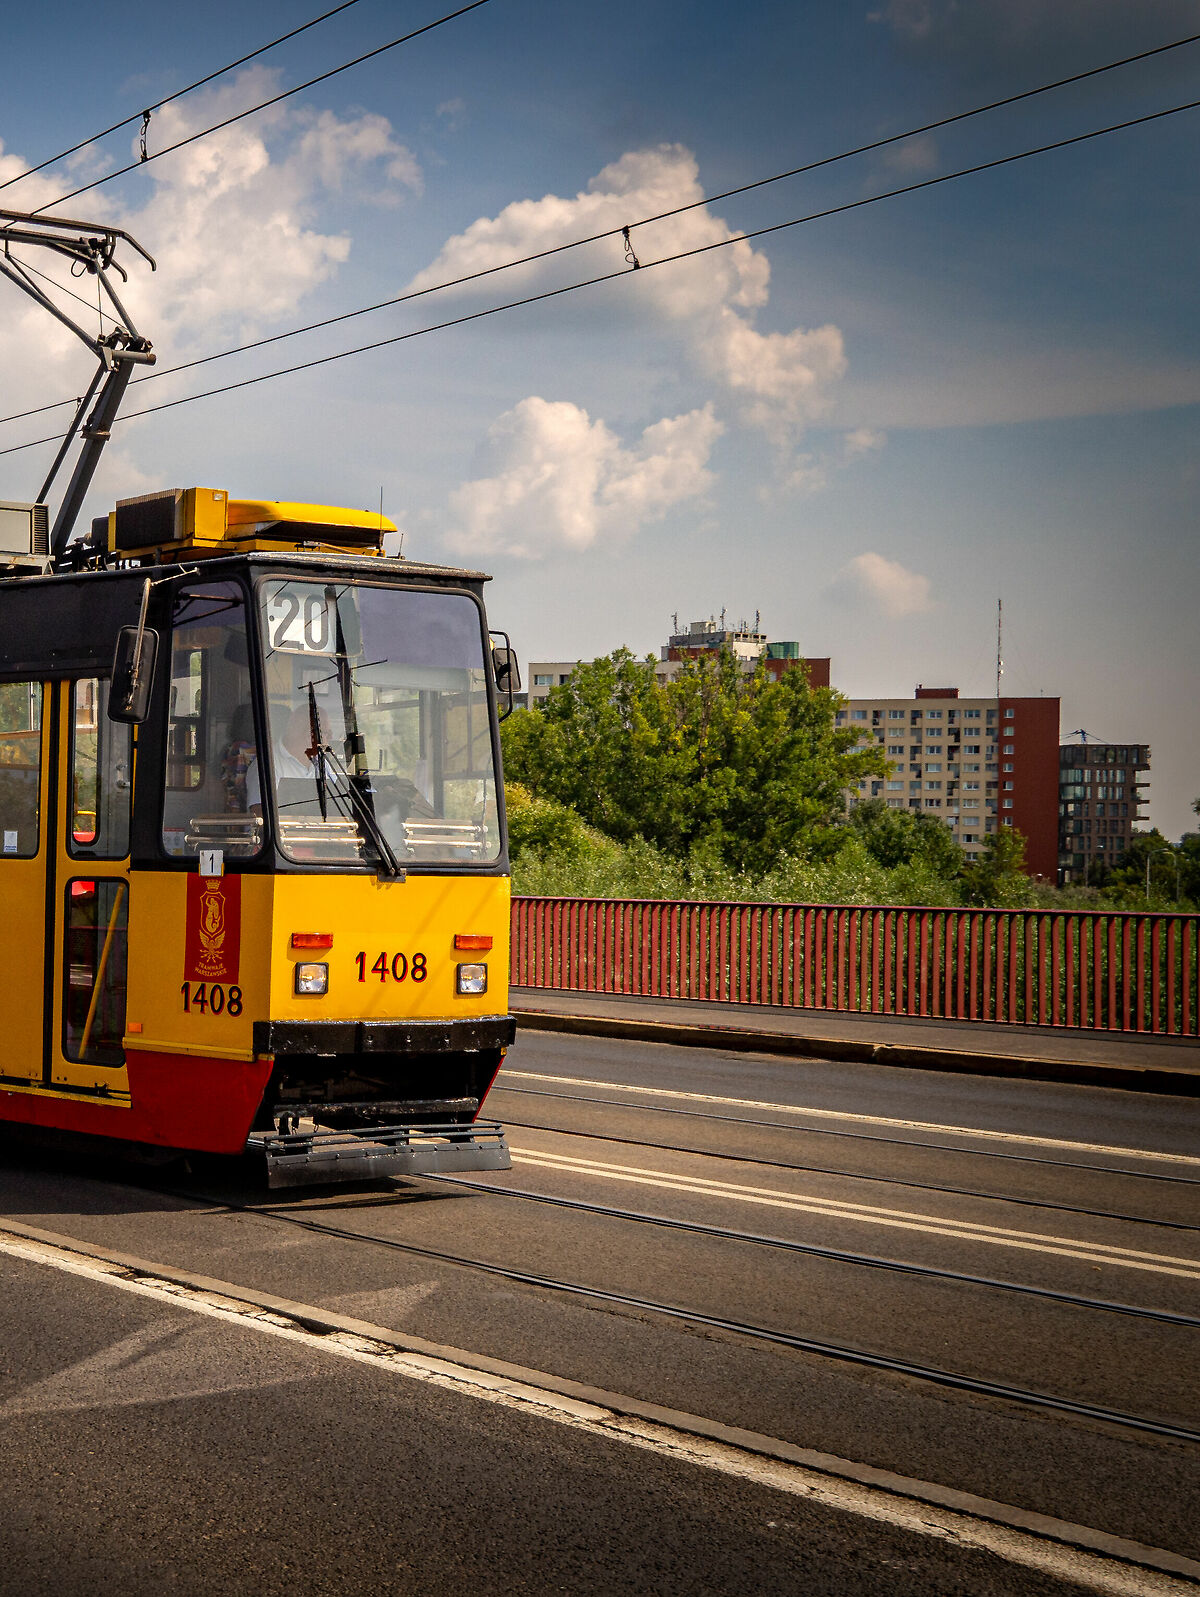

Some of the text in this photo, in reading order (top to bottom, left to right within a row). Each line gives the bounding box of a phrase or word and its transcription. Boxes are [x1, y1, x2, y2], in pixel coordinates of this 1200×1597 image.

[273, 592, 329, 651] 20
[209, 853, 215, 873] 1
[355, 951, 428, 983] 1408
[180, 981, 243, 1017] 1408
